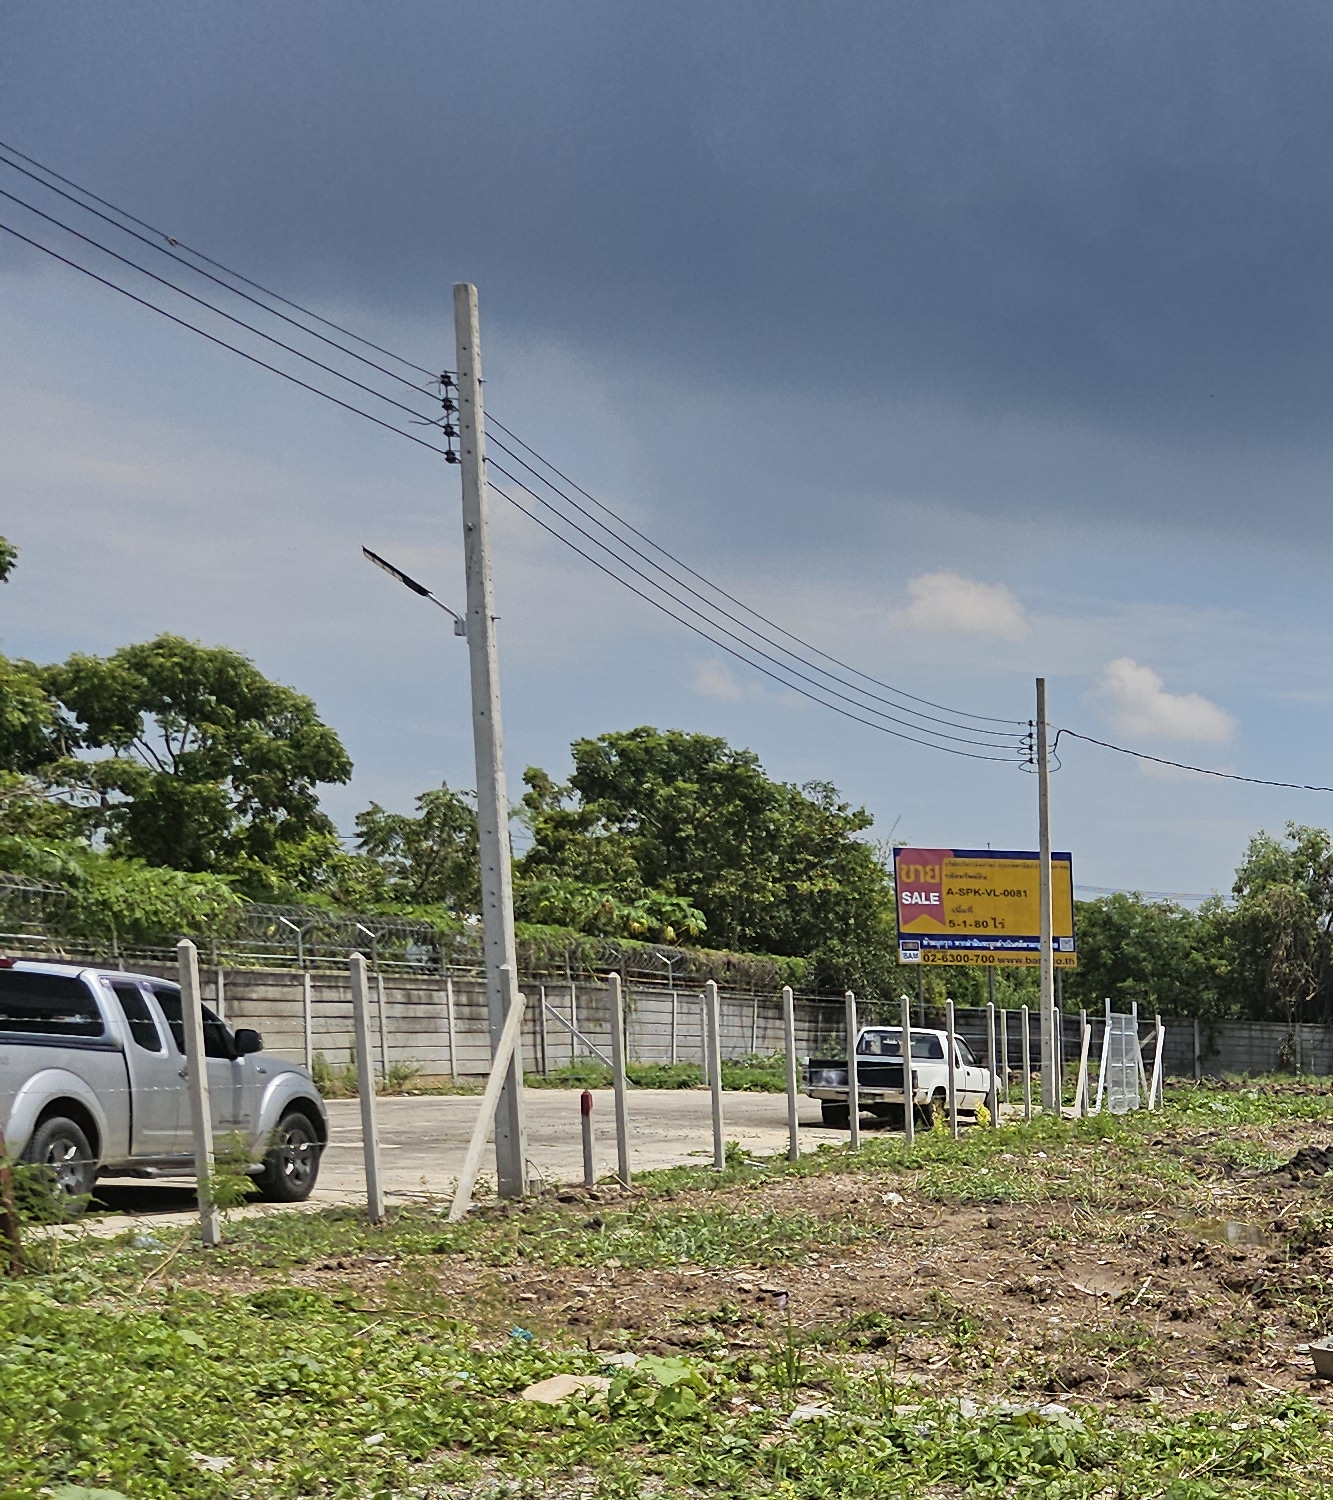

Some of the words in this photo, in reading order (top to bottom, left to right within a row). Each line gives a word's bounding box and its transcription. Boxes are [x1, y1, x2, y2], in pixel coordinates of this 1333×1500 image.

[900, 864, 940, 883] ขาย
[902, 891, 940, 905] SALE
[946, 888, 1028, 898] A-SPK-VL-0081
[923, 954, 995, 964] 02-6300-700
